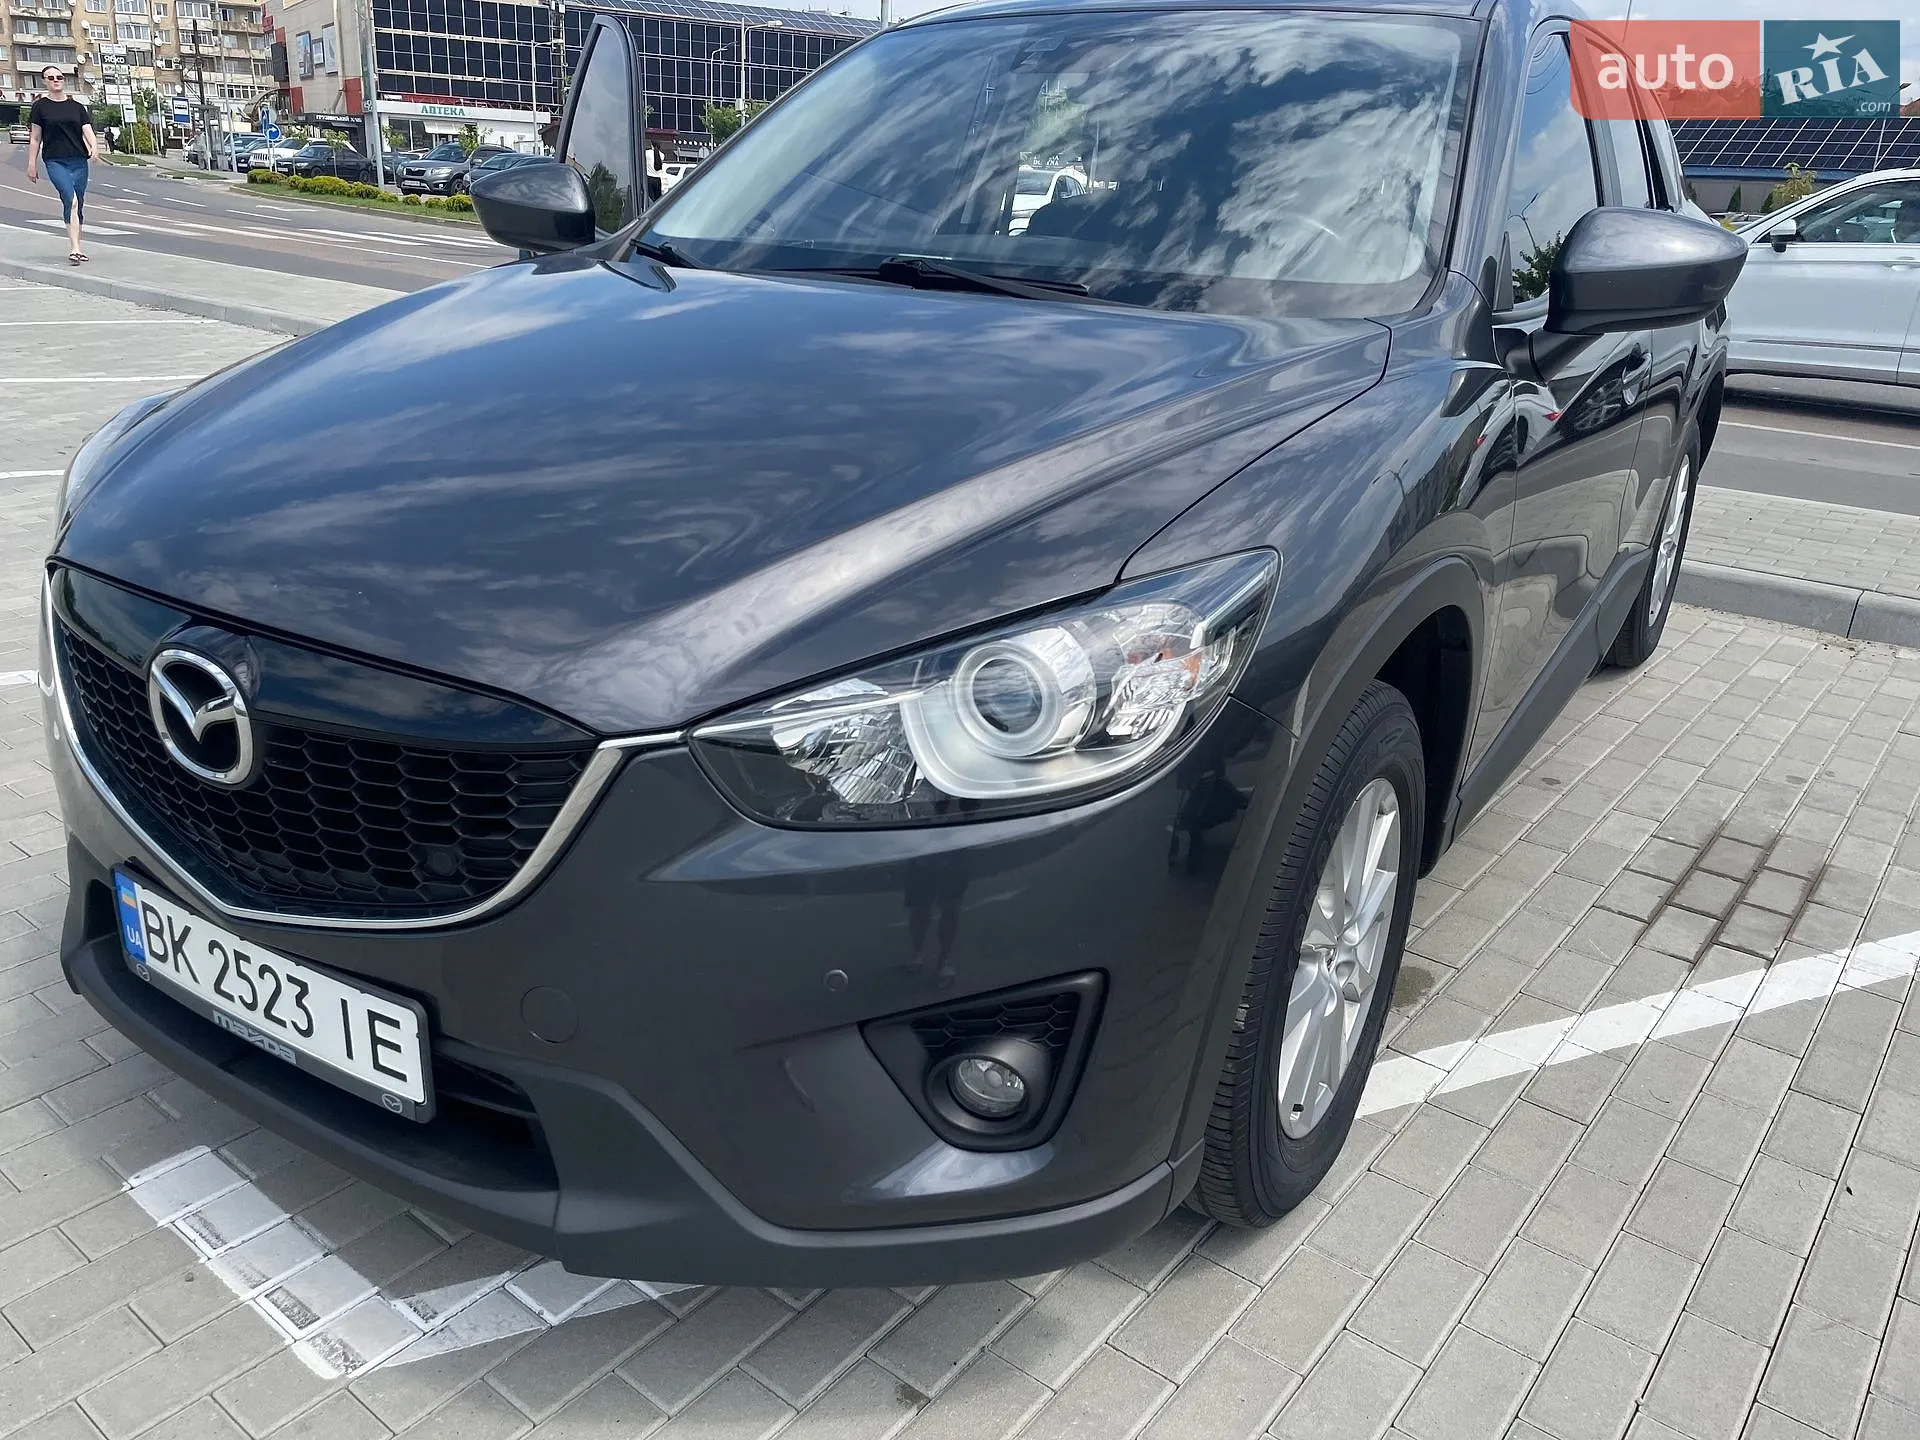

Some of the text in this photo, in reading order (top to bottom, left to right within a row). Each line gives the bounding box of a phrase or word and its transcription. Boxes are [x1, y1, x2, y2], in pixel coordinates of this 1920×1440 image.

[421, 105, 466, 116] АПТЕКА
[126, 924, 144, 950] UA
[141, 900, 408, 1083] BK 2523 IE
